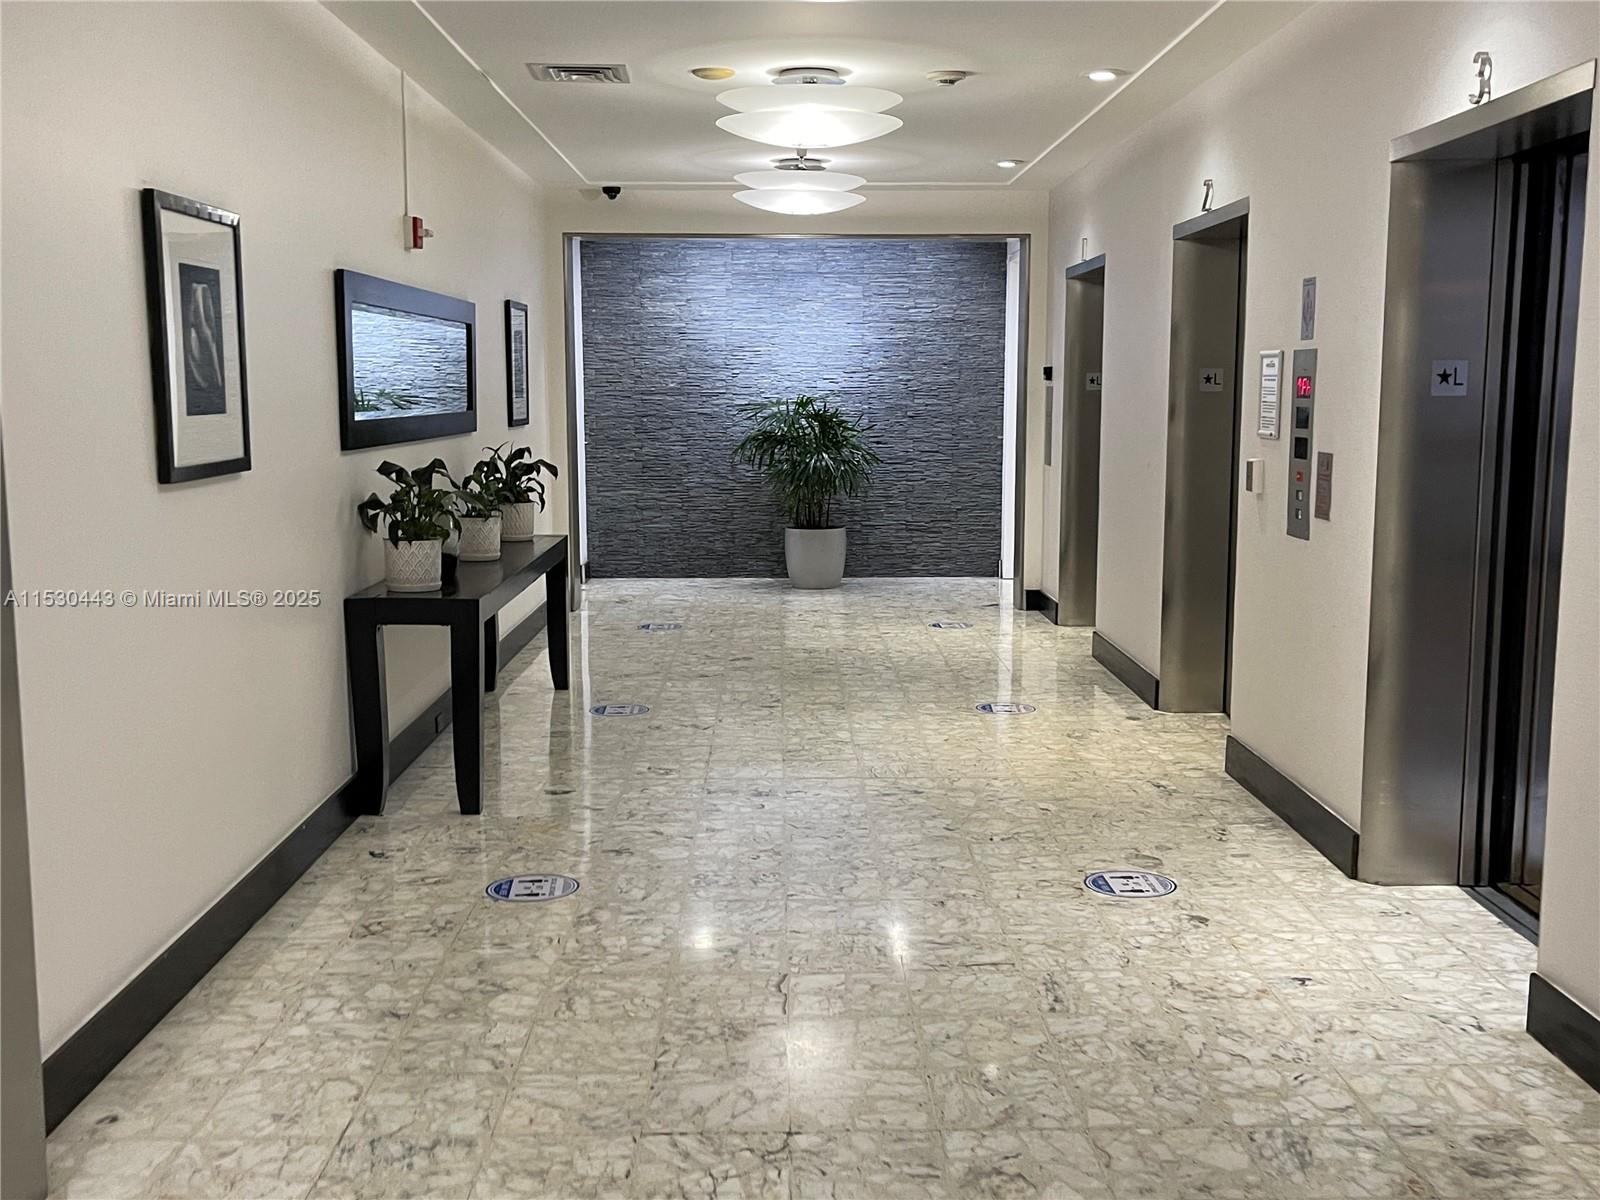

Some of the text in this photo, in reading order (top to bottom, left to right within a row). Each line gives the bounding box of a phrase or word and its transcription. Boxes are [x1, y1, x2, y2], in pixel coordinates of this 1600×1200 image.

[1468, 51, 1493, 104] 3
[1213, 372, 1222, 385] L
[1453, 367, 1465, 386] L
